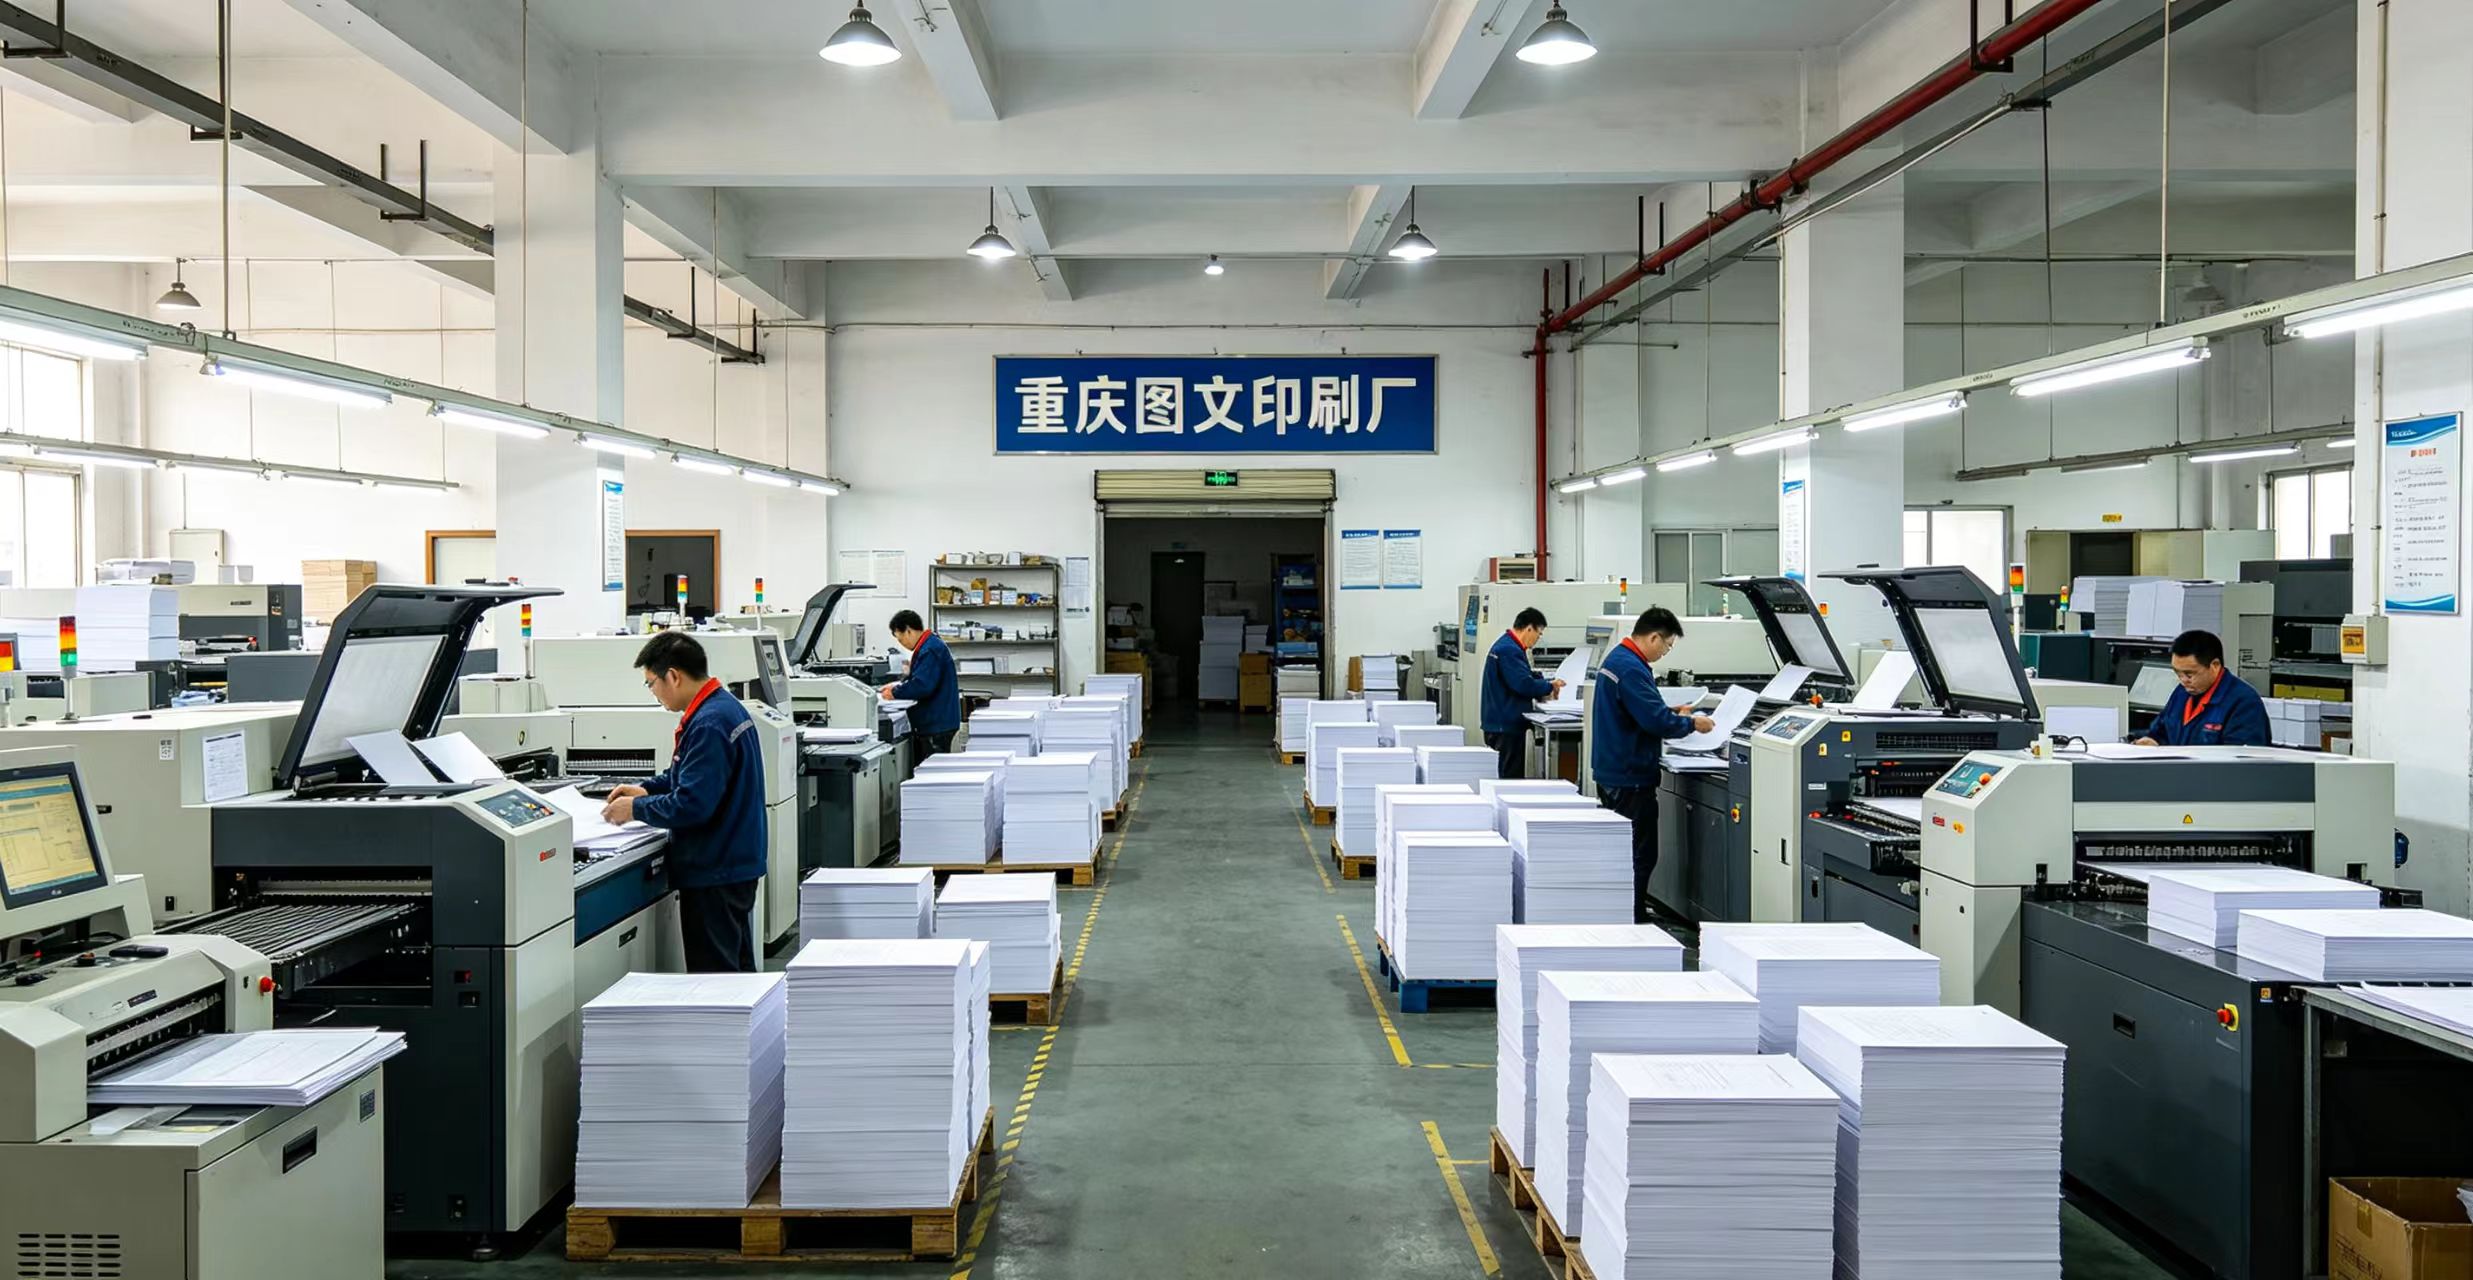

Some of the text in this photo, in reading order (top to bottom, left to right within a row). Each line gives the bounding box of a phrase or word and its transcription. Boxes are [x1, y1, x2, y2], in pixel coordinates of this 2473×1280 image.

[1014, 374, 1417, 435] 重庆图文印刷厂
